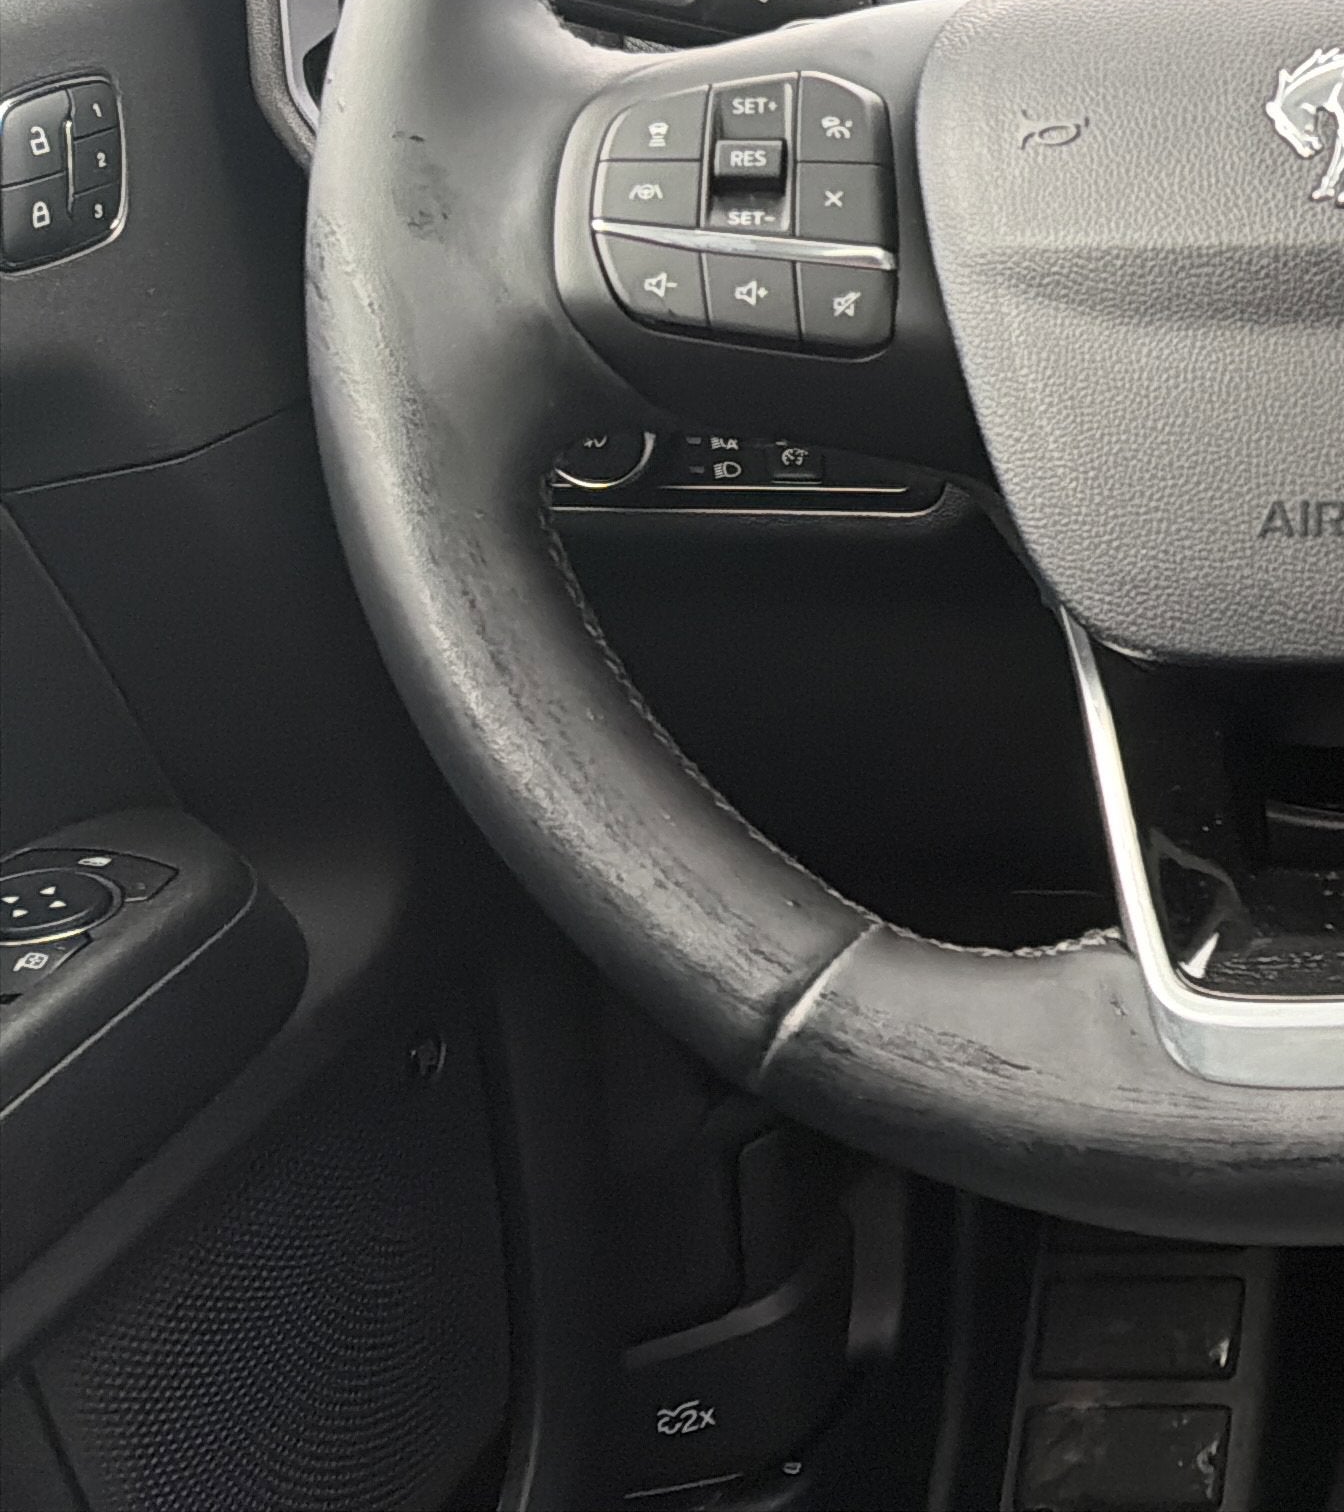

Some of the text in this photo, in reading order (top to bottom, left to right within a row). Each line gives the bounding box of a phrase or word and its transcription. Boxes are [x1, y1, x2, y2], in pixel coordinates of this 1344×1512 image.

[92, 103, 103, 118] 1
[97, 152, 107, 167] 2
[730, 150, 768, 167] RES
